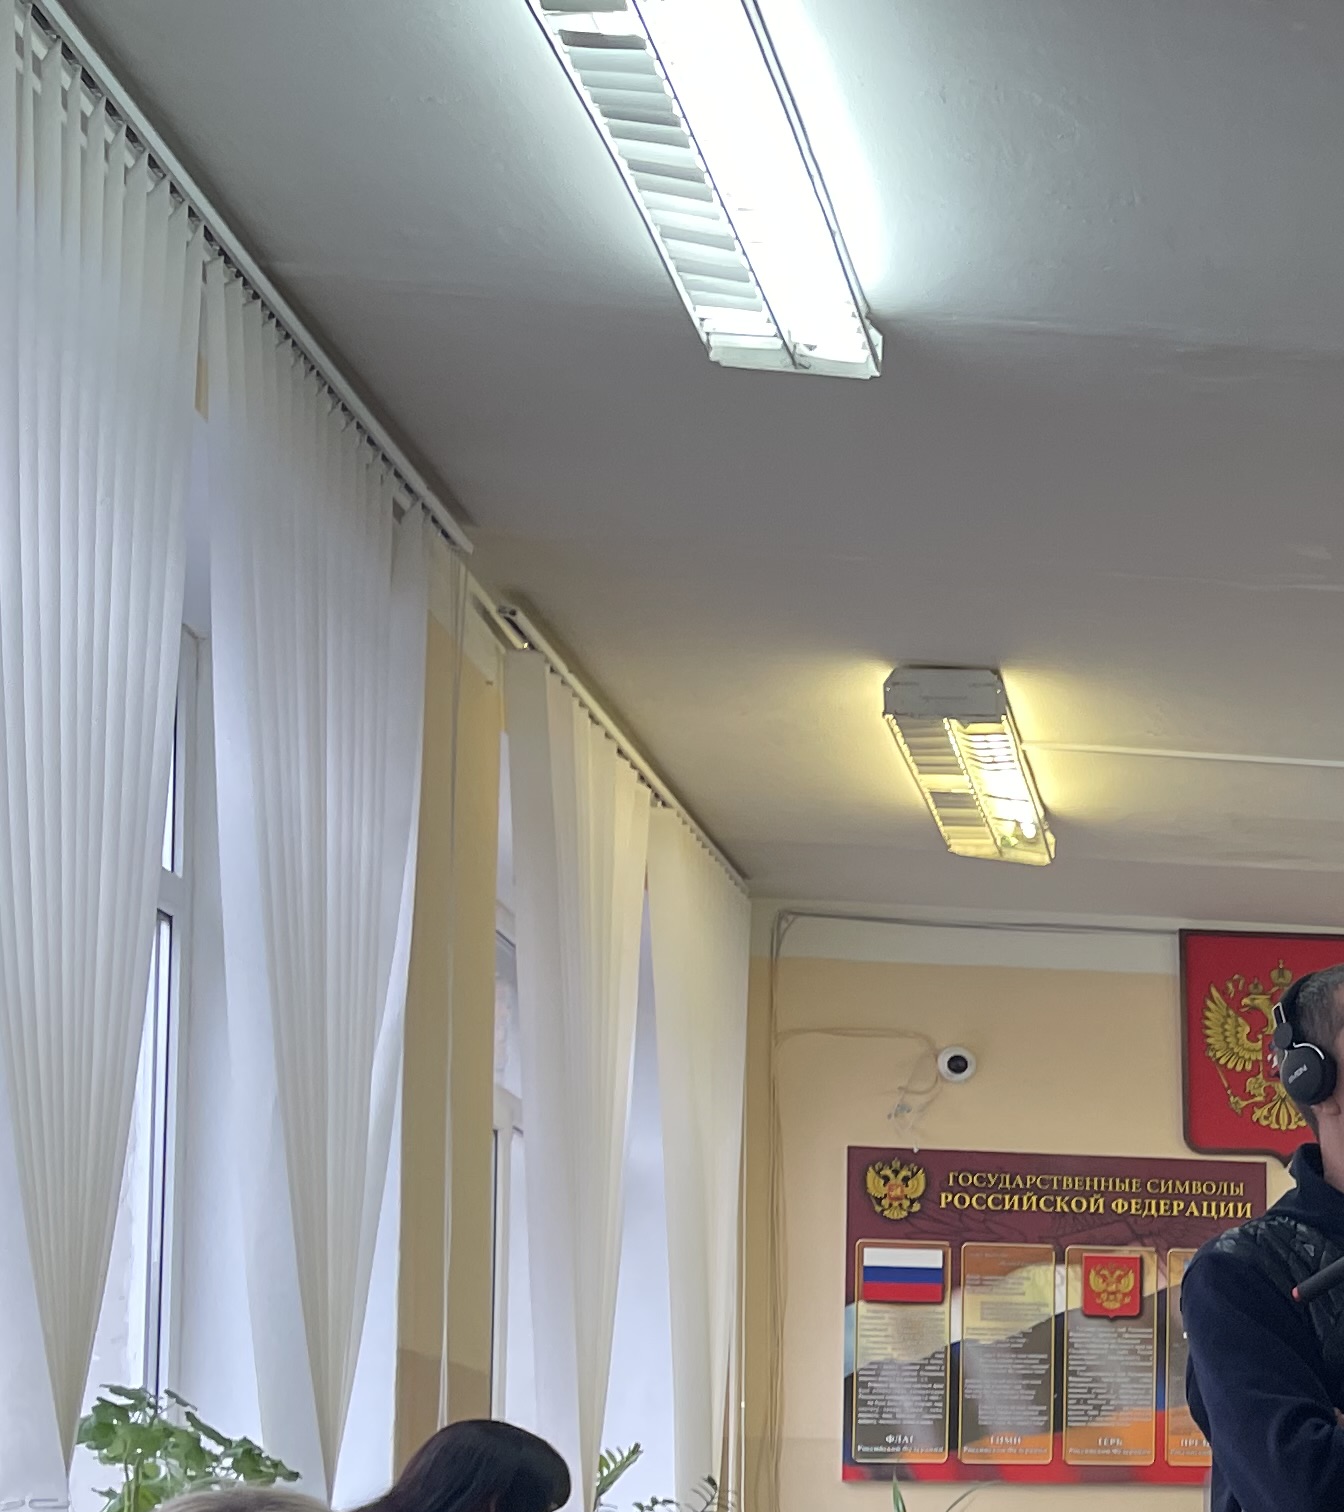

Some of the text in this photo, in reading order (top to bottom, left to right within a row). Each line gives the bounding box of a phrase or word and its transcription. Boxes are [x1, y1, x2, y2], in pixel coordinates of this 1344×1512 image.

[948, 1171, 1245, 1197] ГОСУДАРСТВЕННЫЕ СИМВОЛЫ
[939, 1190, 1252, 1220] РОССИЙСКОЙ ФЕДЕРАЦИИ
